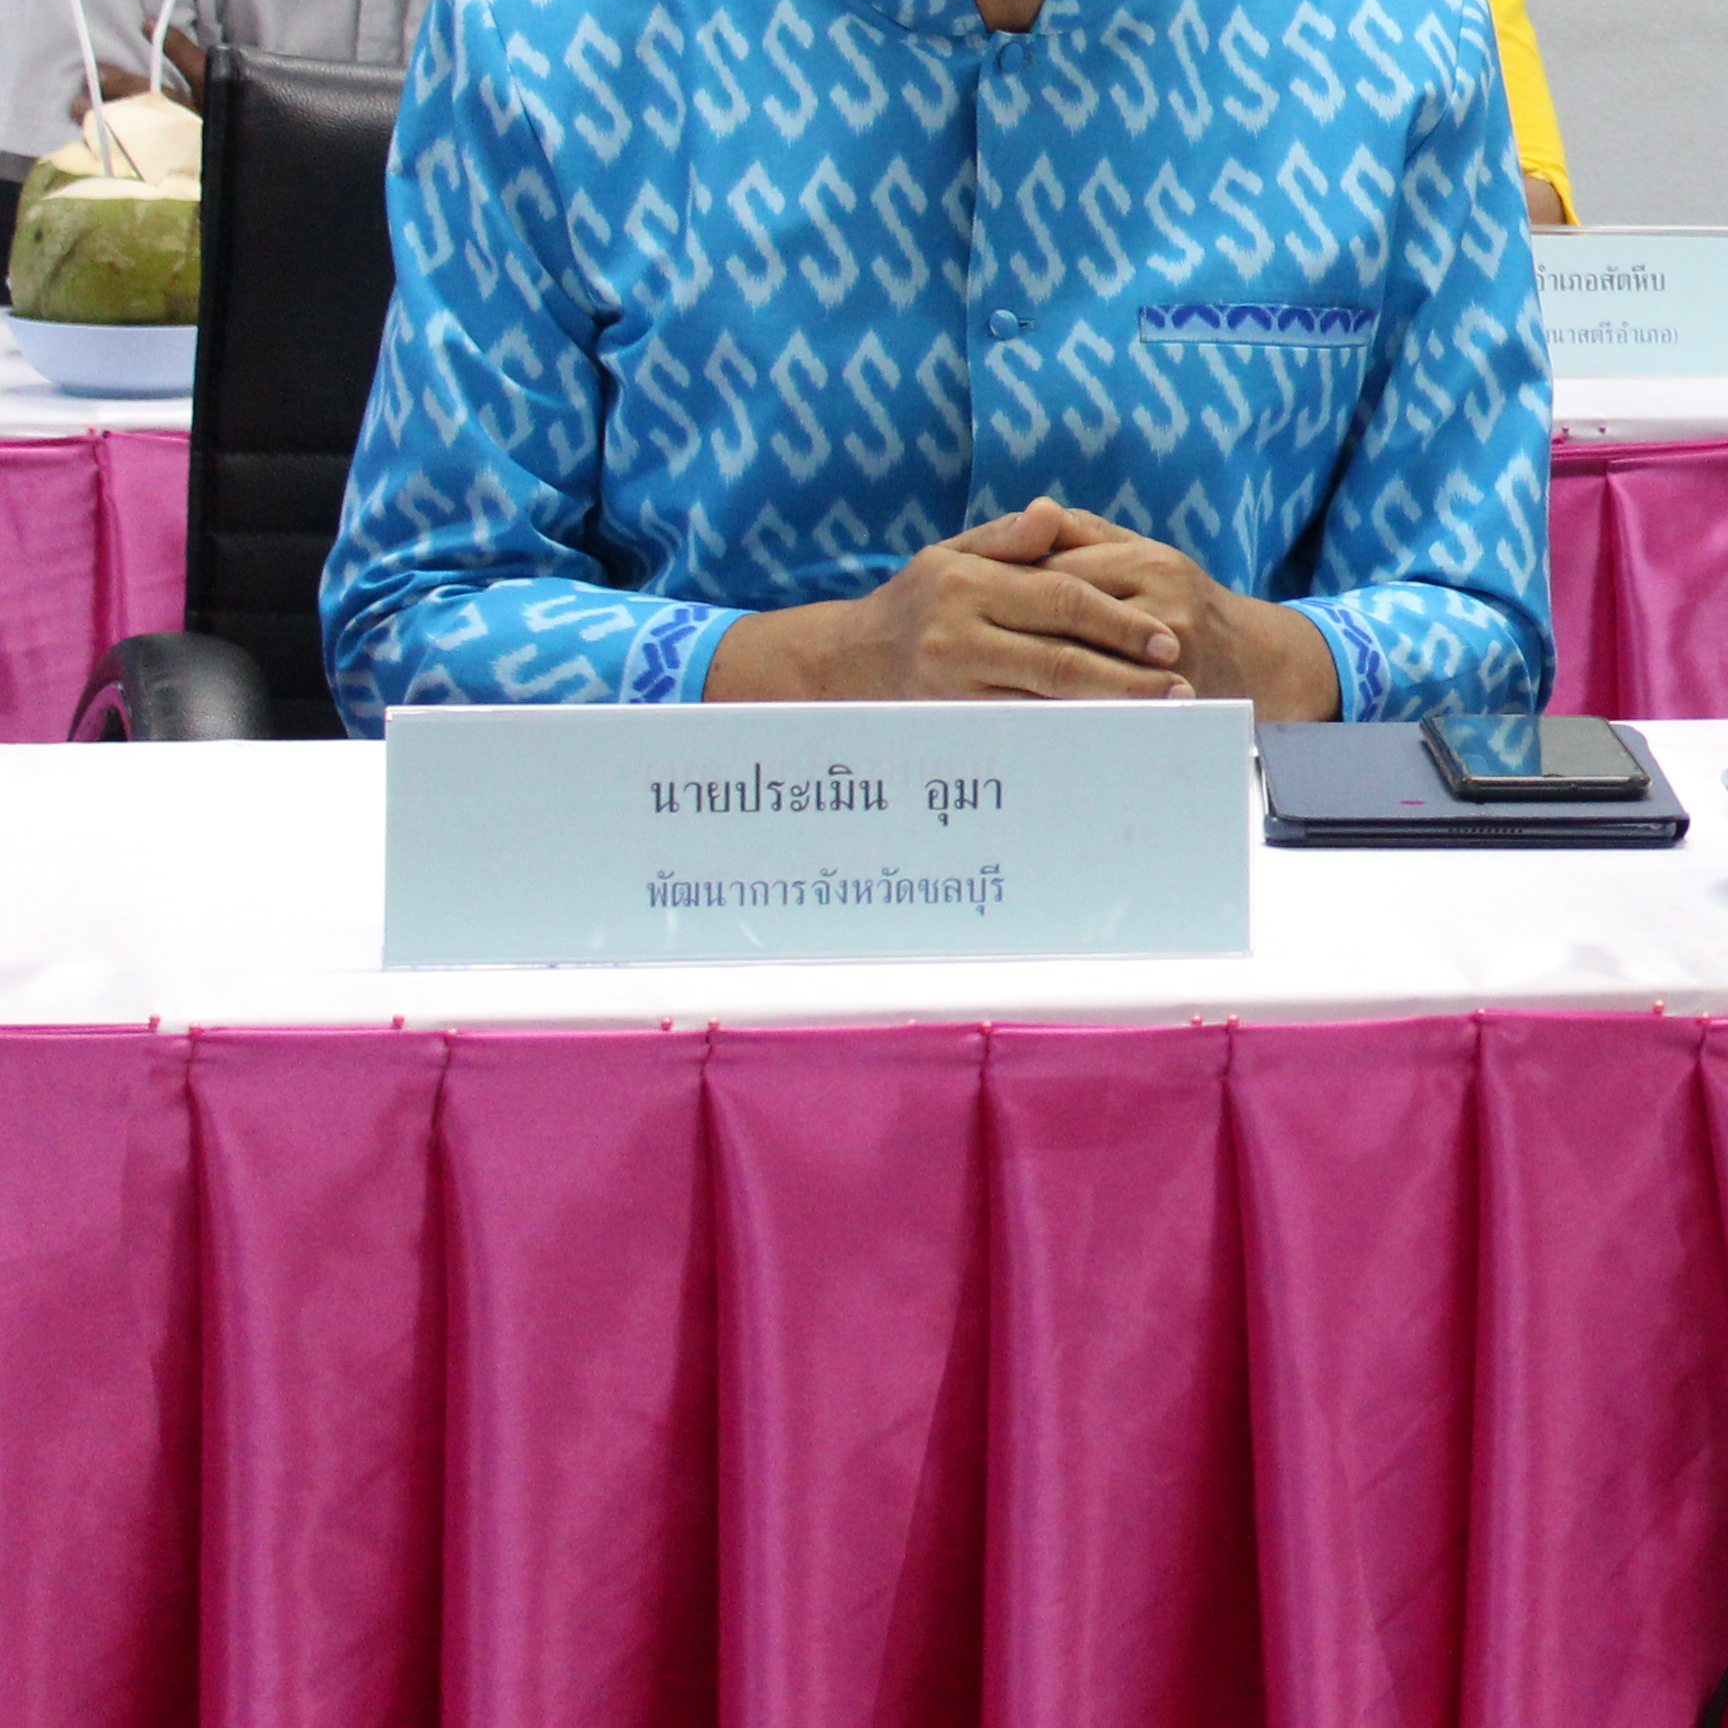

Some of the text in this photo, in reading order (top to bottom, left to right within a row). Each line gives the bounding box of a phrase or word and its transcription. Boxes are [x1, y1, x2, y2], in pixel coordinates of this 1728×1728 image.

[649, 761, 1004, 828] นายประเมิน อุมา
[646, 862, 1006, 917] พัฒนาการจังหวัดชลบุรี
